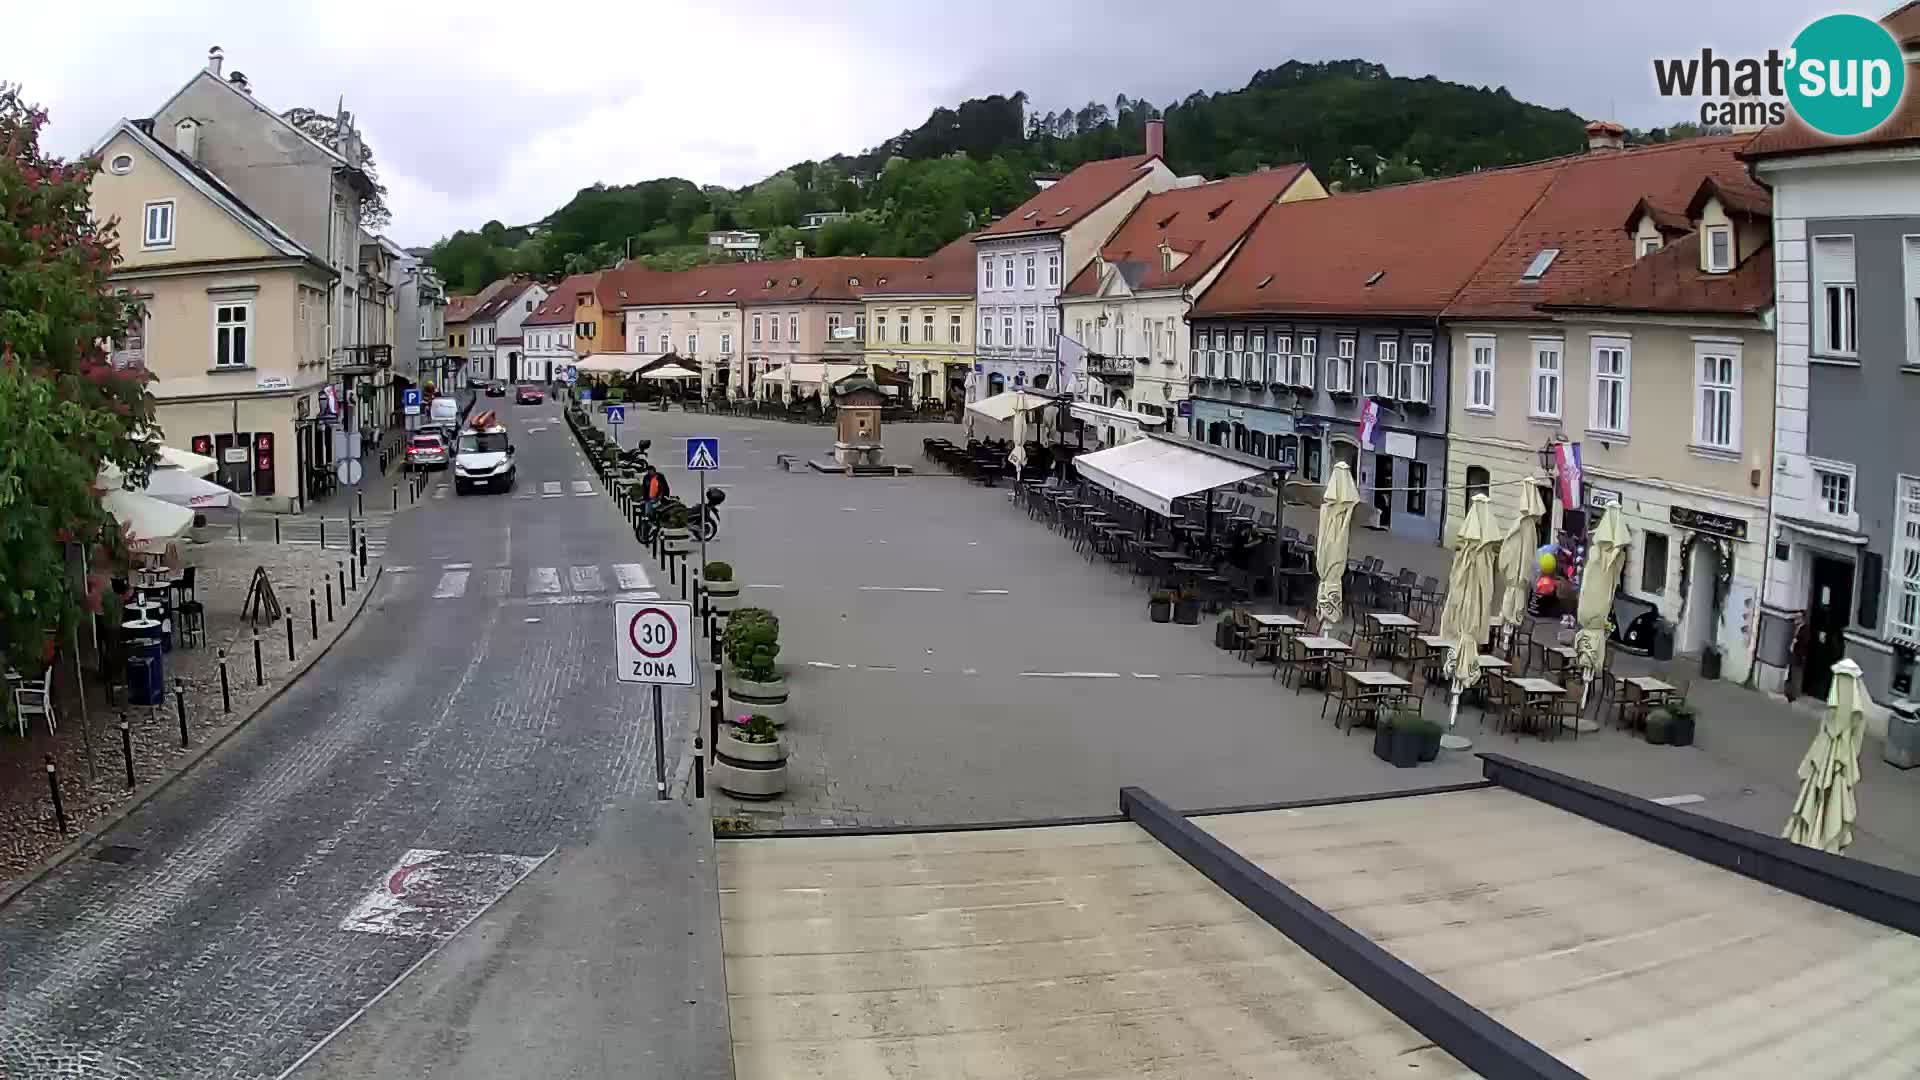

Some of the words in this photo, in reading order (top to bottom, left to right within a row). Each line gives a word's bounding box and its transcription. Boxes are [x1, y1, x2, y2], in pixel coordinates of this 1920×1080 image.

[408, 392, 417, 404] P
[642, 623, 666, 645] 30
[632, 660, 677, 678] ZONA
